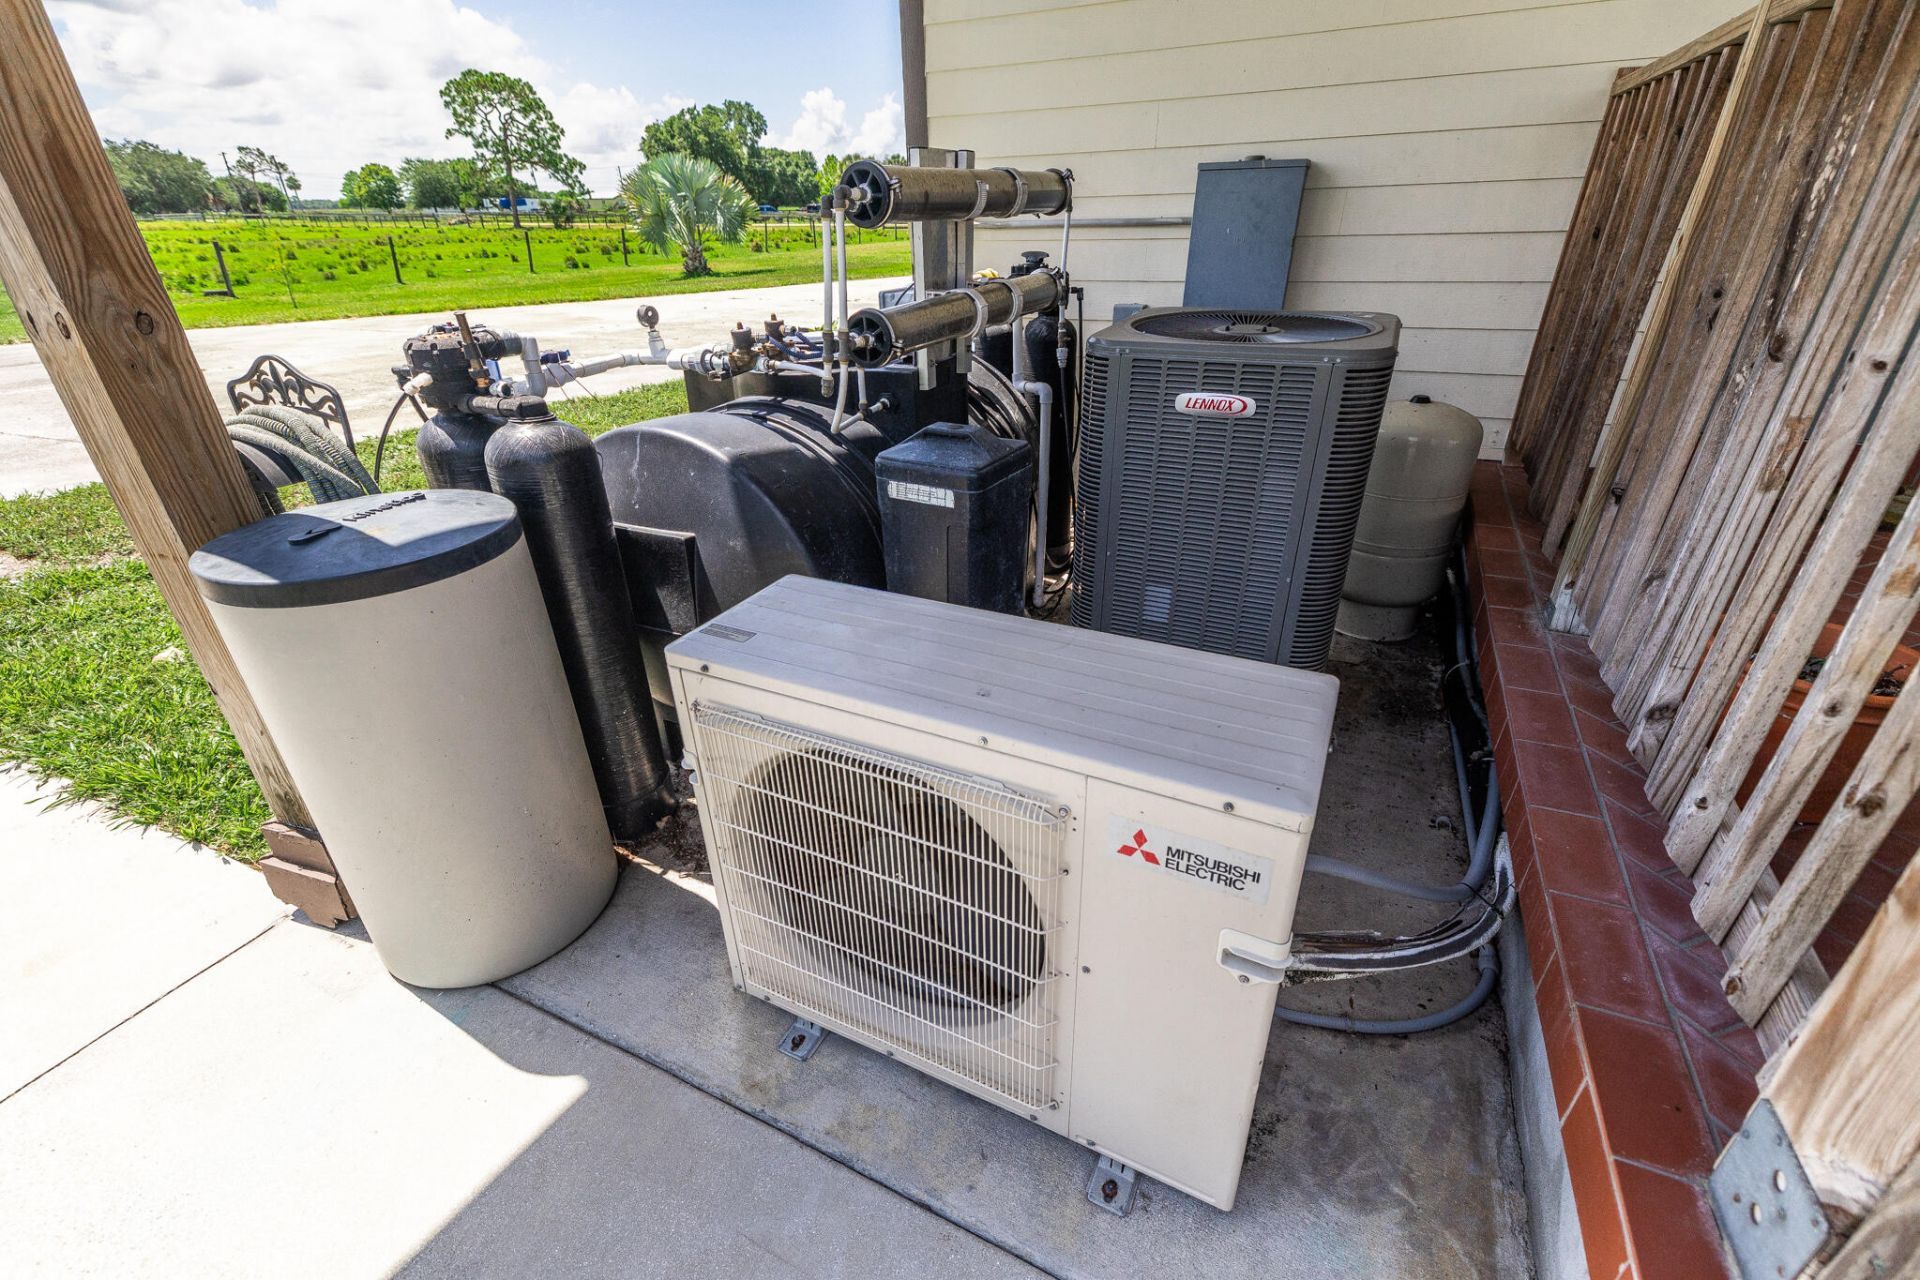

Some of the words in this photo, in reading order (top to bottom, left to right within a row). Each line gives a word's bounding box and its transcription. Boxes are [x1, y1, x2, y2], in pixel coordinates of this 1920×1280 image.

[1185, 397, 1236, 412] LENNOX
[1165, 858, 1246, 891] ELECTRIC
[1166, 846, 1262, 884] MITSUBISHI
